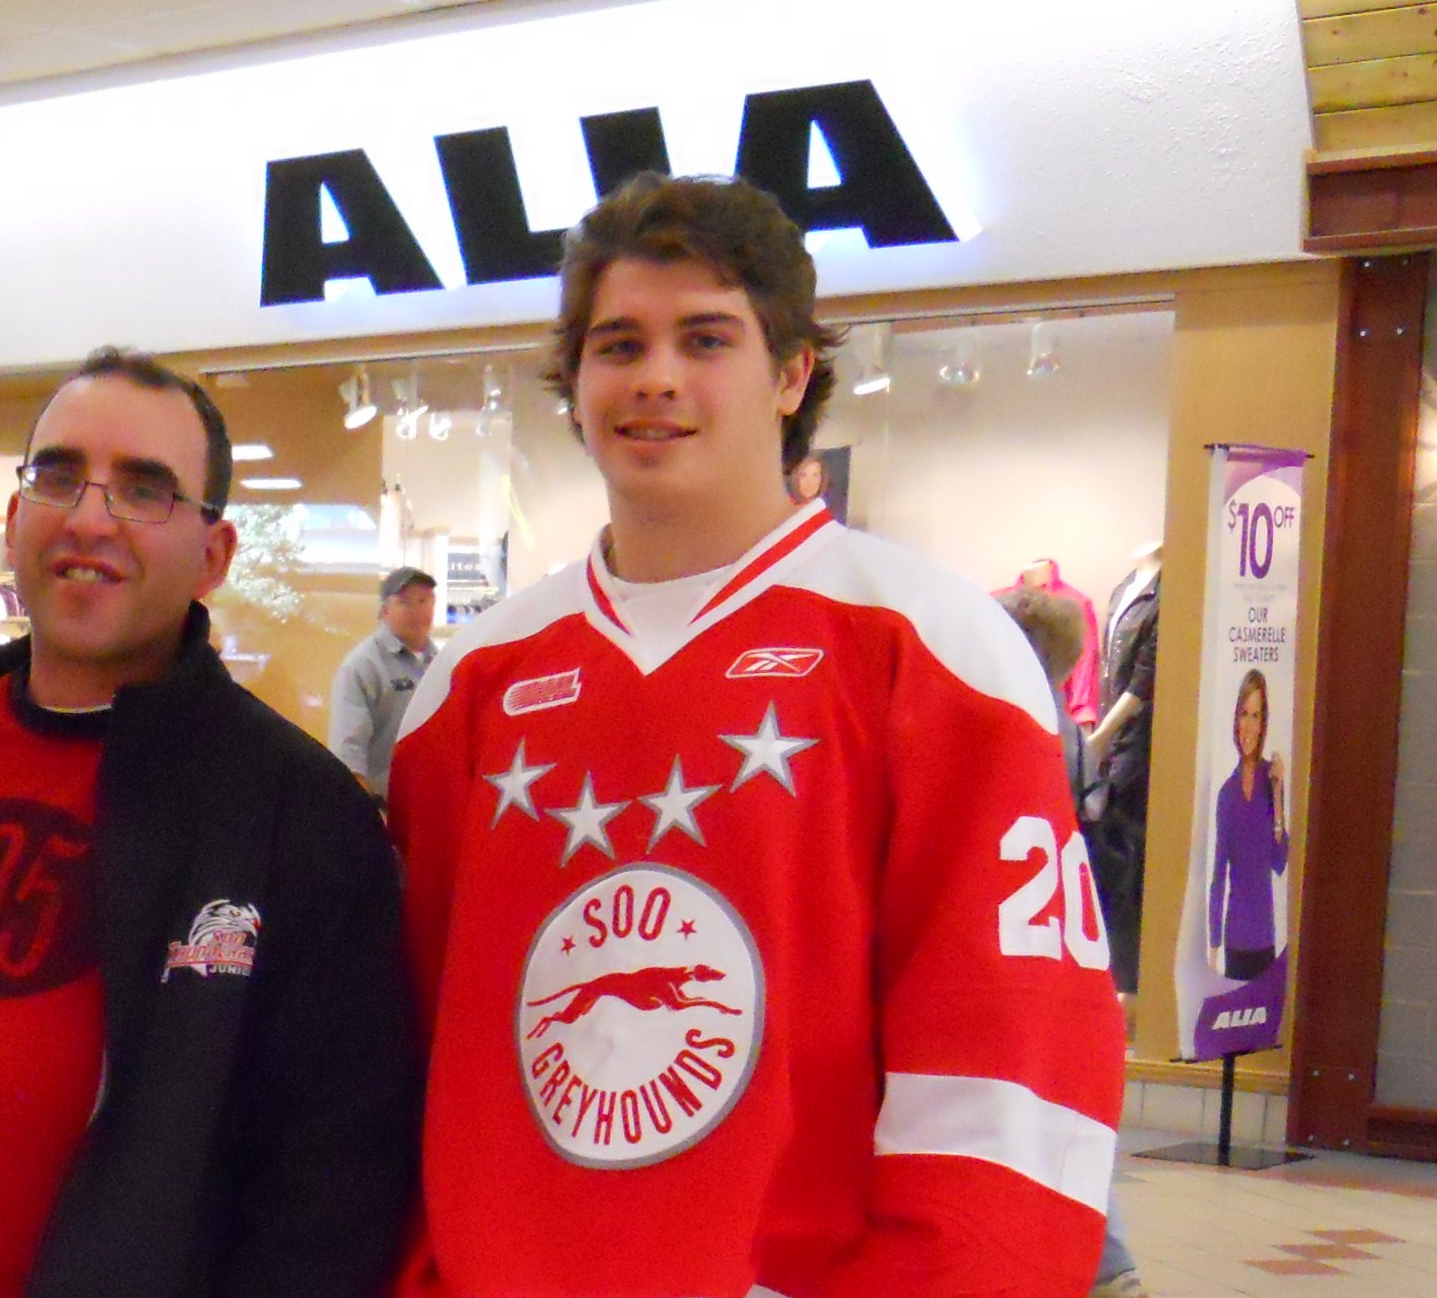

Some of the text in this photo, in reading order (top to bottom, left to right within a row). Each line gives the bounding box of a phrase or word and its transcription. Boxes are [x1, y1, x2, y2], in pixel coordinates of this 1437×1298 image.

[1228, 499, 1295, 579] $10 OFF
[1248, 607, 1268, 623] OUR
[1233, 646, 1279, 663] SWEATERS
[582, 884, 672, 948] SOO
[998, 816, 1111, 972] 20
[530, 1027, 737, 1147] GREYHOUNDS
